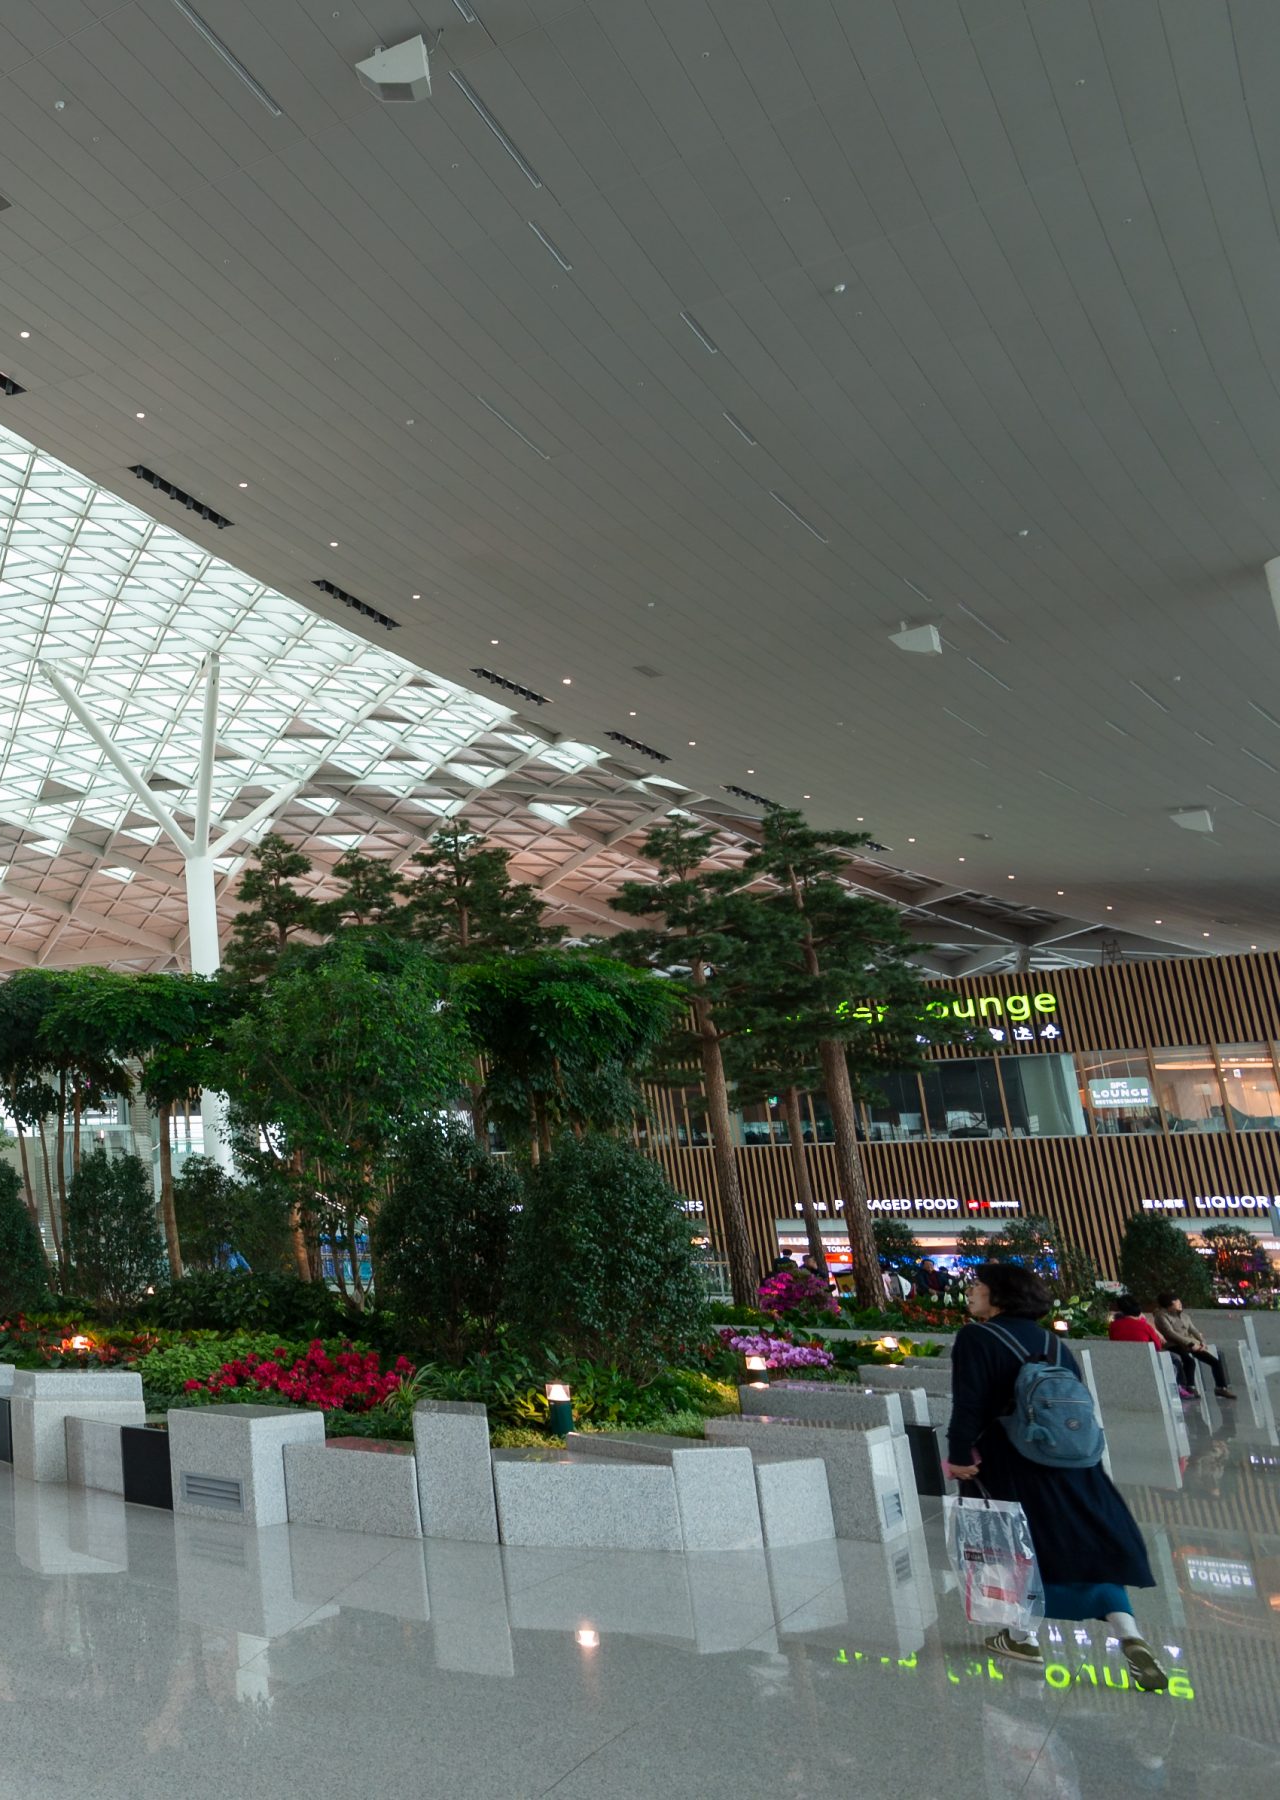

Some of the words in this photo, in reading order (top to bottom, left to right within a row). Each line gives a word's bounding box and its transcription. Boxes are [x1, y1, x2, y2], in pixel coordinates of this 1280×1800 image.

[916, 993, 1057, 1021] ounge
[1092, 1088, 1149, 1098] LOUNGE
[914, 1199, 959, 1210] FOOD
[1195, 1195, 1270, 1208] LIQUOR
